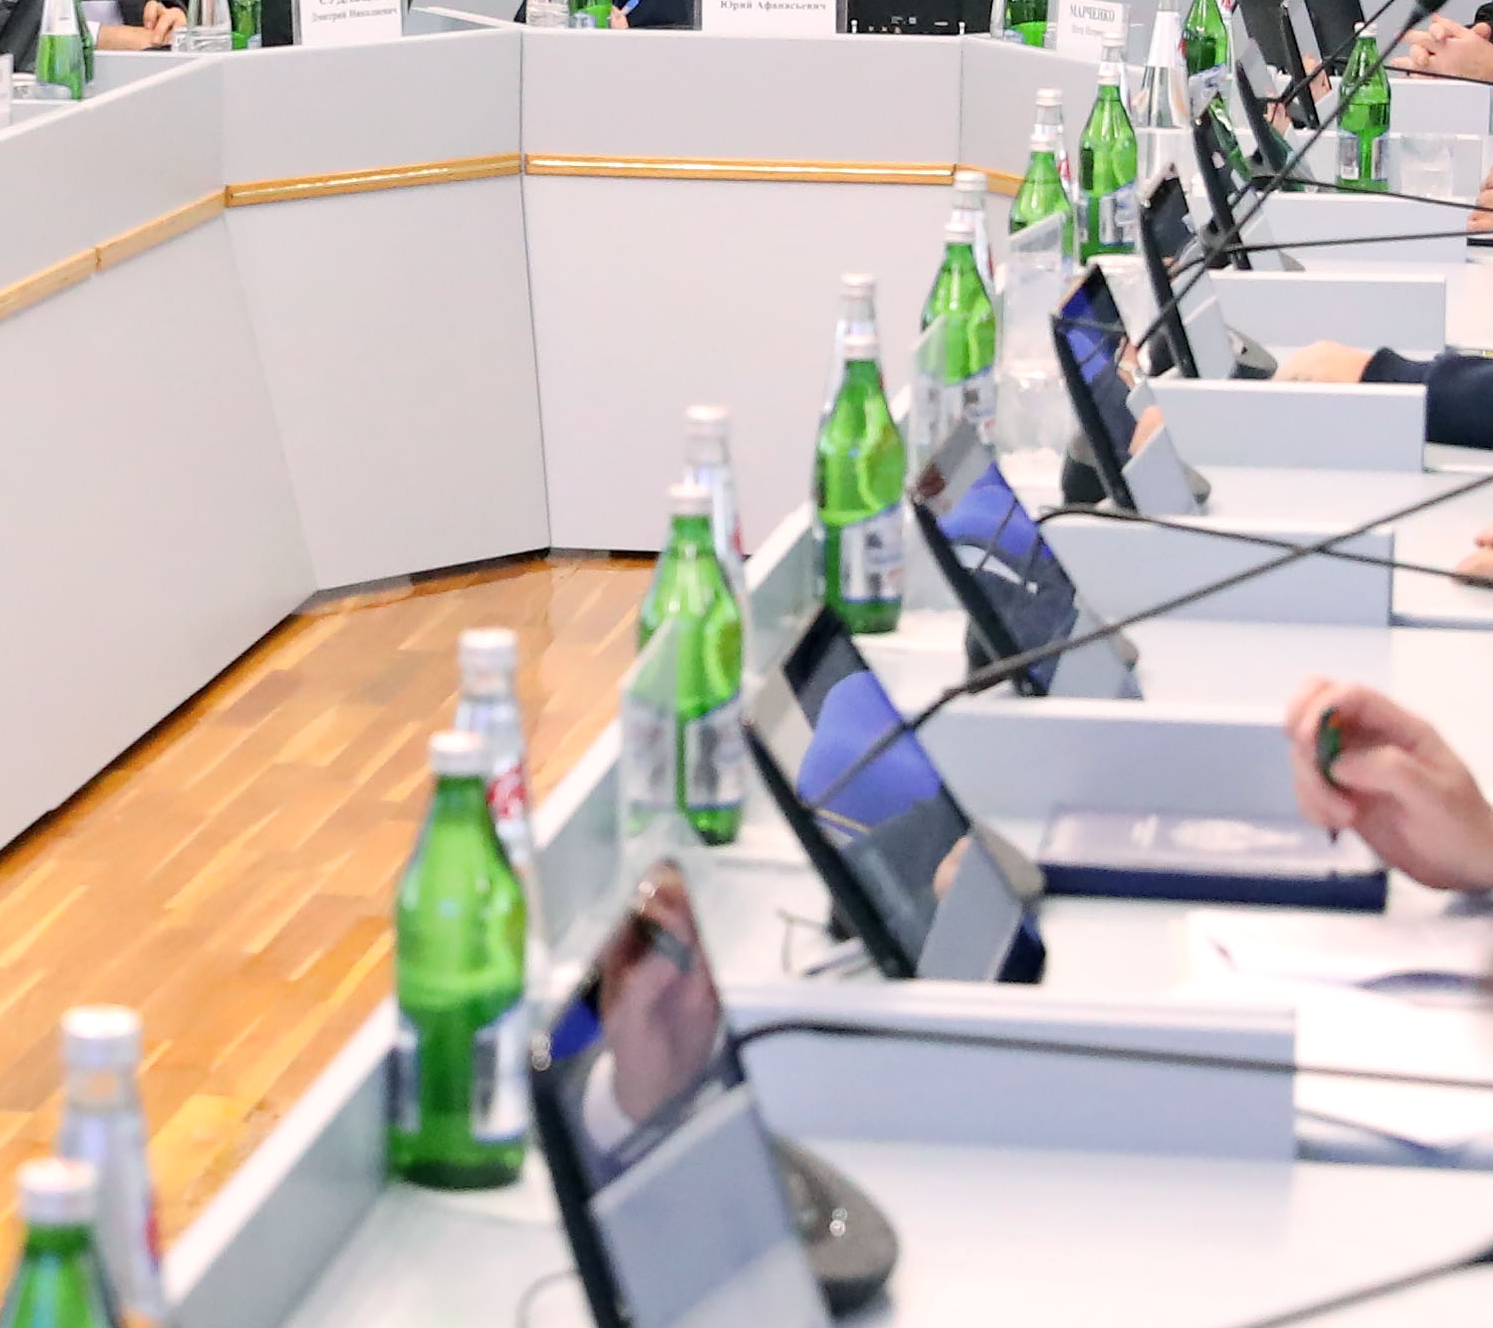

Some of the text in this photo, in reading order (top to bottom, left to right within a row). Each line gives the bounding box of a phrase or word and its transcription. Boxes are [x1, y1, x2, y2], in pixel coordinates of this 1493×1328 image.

[720, 0, 826, 12] Юрий Афанасьевич
[1070, 3, 1115, 22] МАРЧЕНКО
